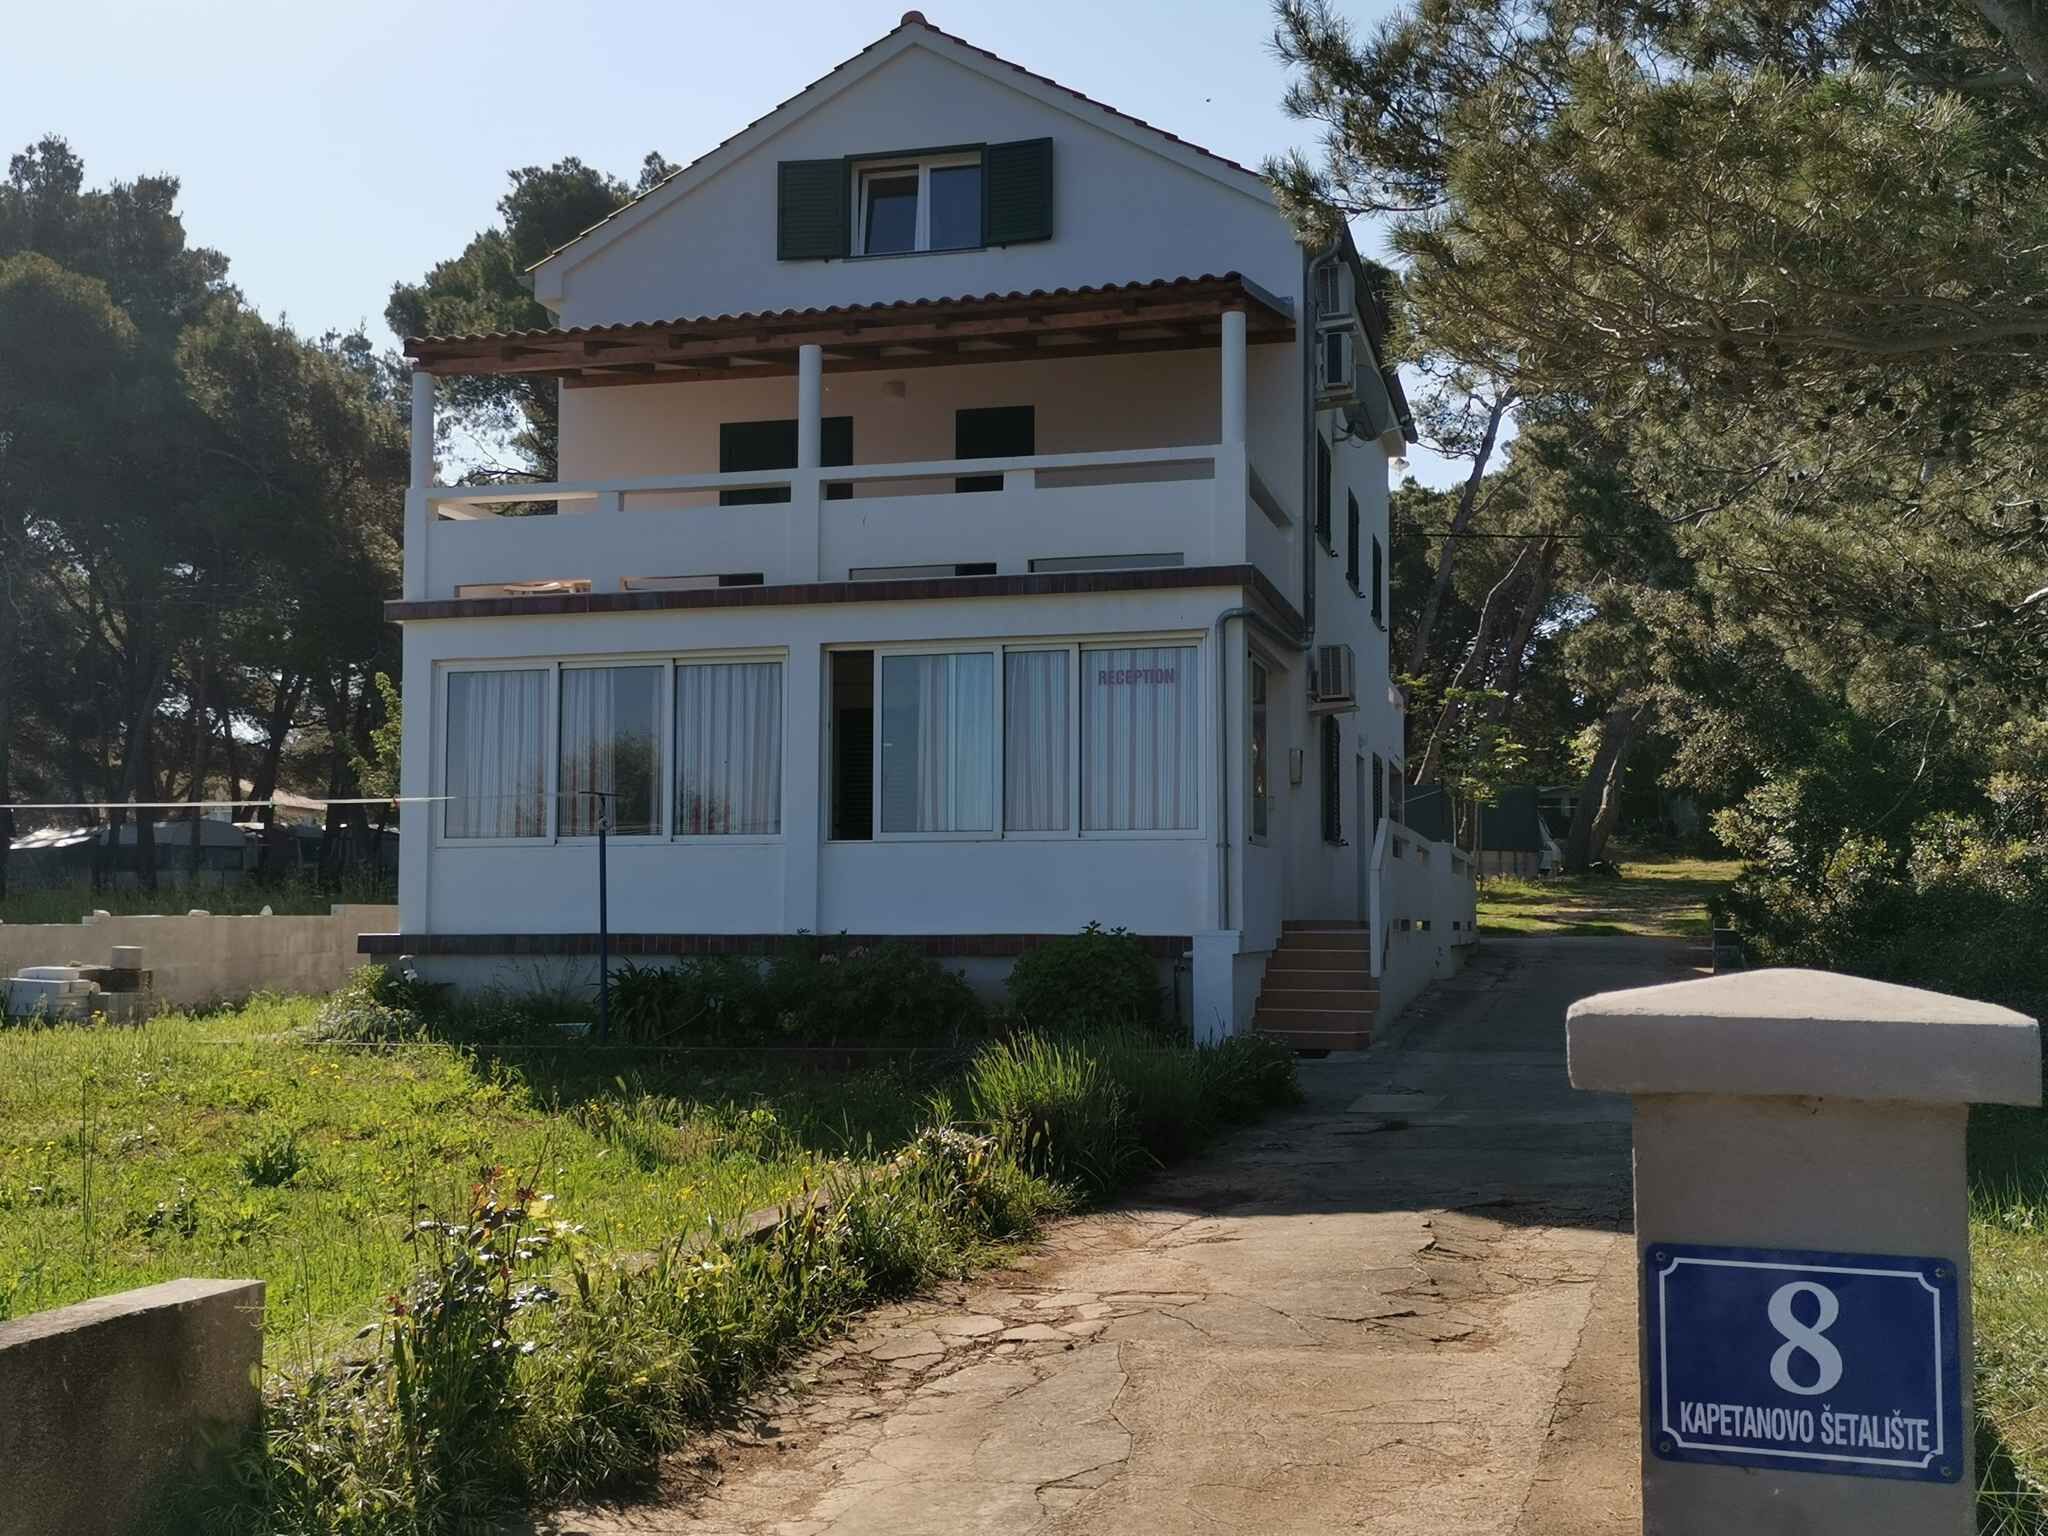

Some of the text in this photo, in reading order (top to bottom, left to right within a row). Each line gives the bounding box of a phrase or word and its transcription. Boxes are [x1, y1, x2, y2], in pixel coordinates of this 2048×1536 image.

[1098, 667, 1175, 686] RECEPTION
[1767, 1280, 1843, 1395] 8
[1680, 1401, 1930, 1451] KAPETANOVO ŠETALIŠTE
